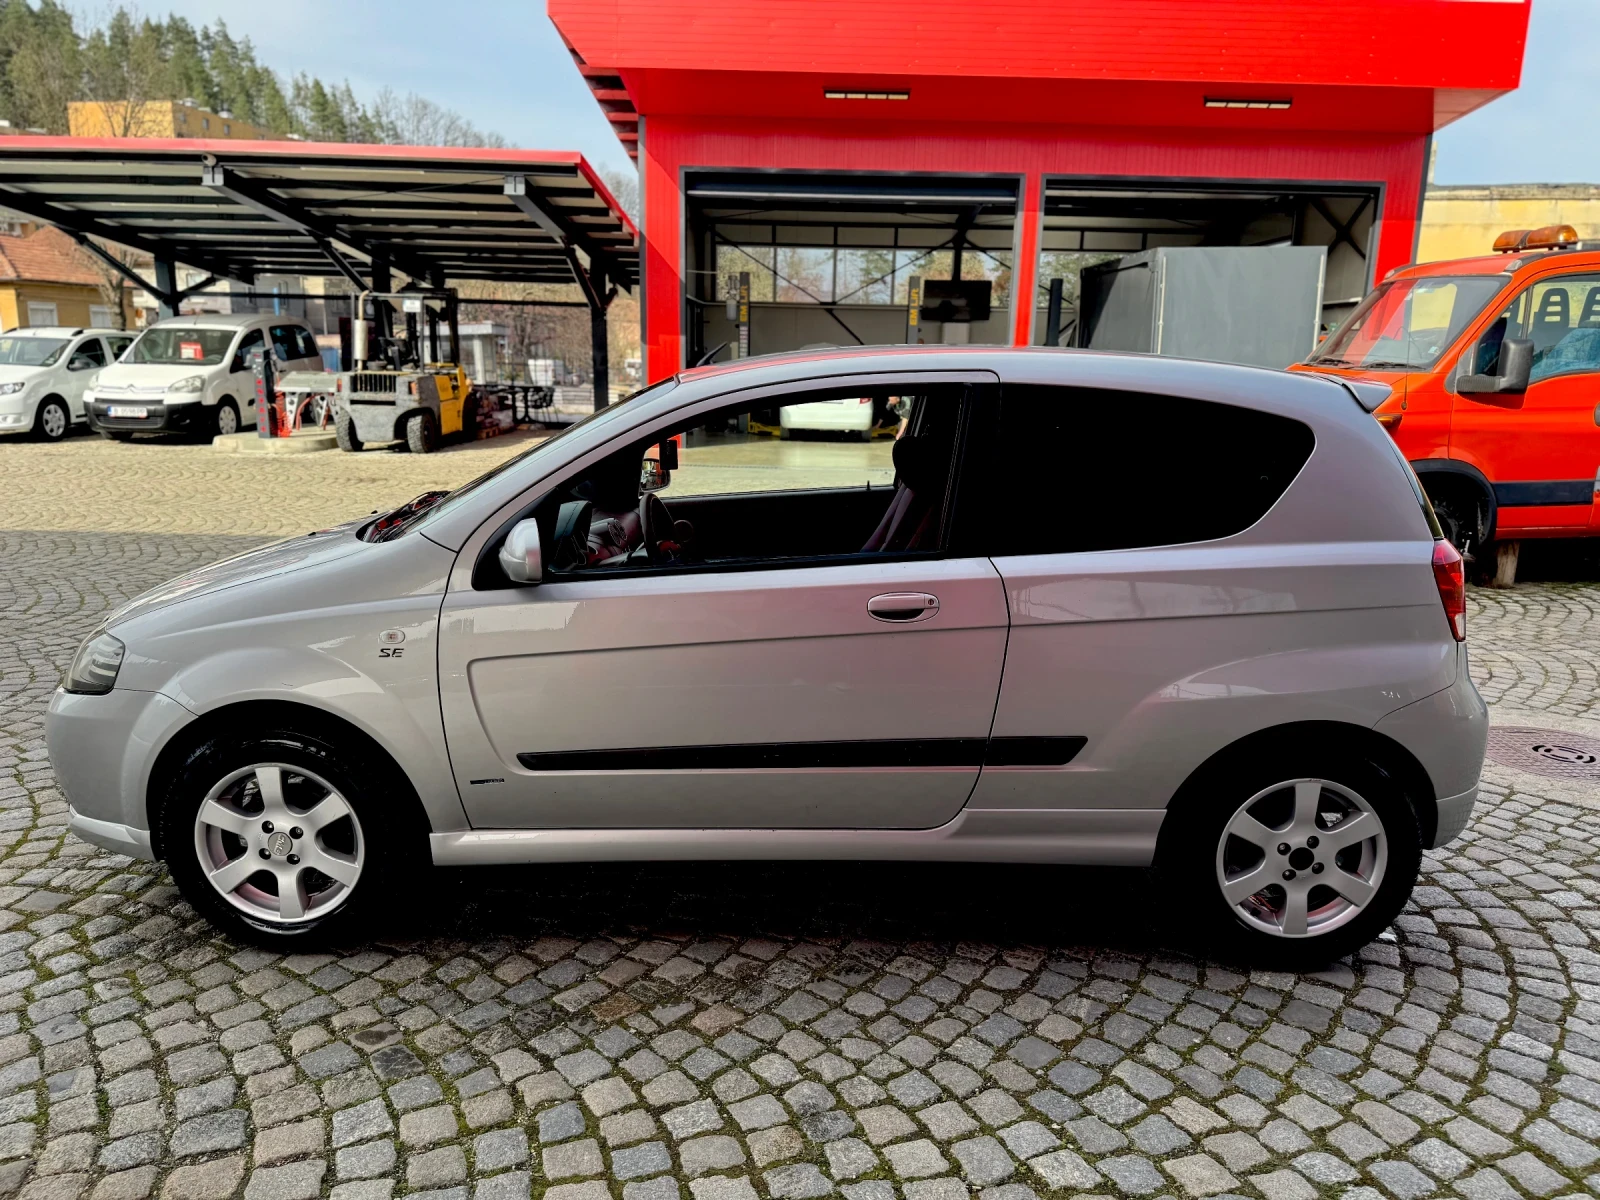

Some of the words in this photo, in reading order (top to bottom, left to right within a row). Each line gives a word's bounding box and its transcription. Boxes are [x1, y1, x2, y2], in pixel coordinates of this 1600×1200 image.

[740, 305, 748, 322] EM
[910, 309, 918, 326] EM
[379, 648, 404, 658] SE
